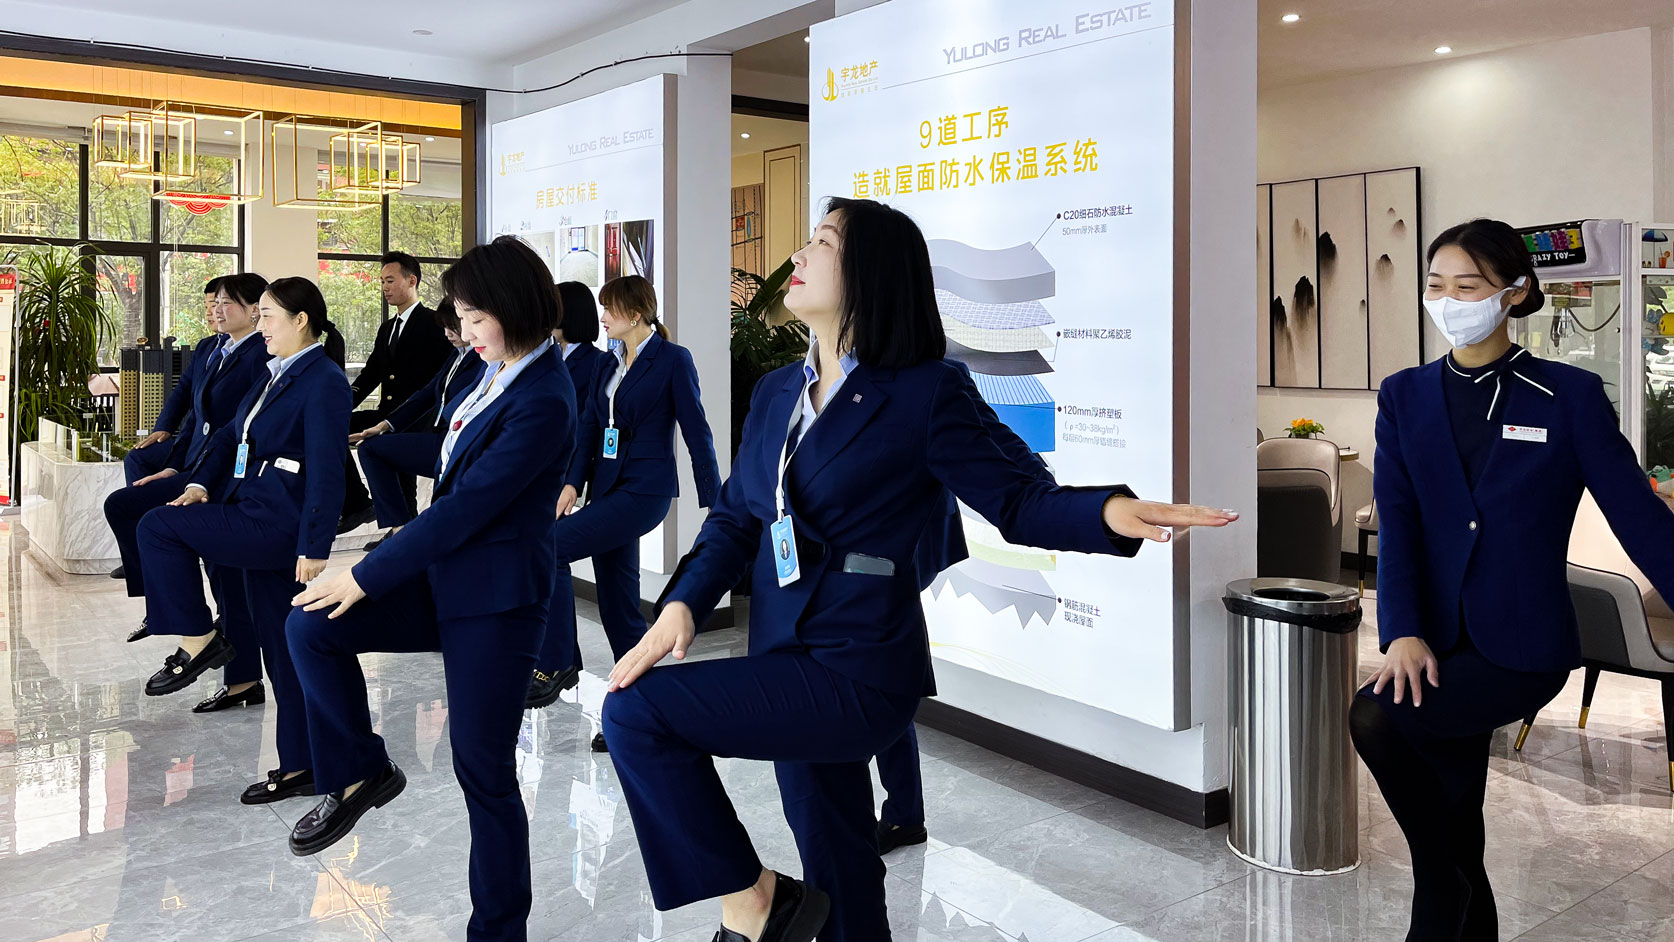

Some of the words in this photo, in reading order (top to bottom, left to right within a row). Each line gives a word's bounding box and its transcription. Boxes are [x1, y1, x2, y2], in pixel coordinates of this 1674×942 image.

[943, 37, 1010, 65] YULONG
[1018, 24, 1067, 48] REAL
[1075, 3, 1152, 34] ESTATE
[841, 60, 878, 82] 宇龙地产
[919, 105, 1010, 149] 9道工序
[600, 136, 620, 149] REAL
[623, 128, 655, 144] ESTATE
[853, 138, 1099, 199] 造就屋面防水保温系统
[536, 180, 598, 209] 房屋交付标准
[1063, 204, 1133, 220] C20细石防水混凝土
[1063, 328, 1132, 340] 嵌缝材料聚乙烯胶泥
[1063, 405, 1122, 419] 120mm厚挤塑板
[1064, 598, 1101, 617] 钢筋混凝土
